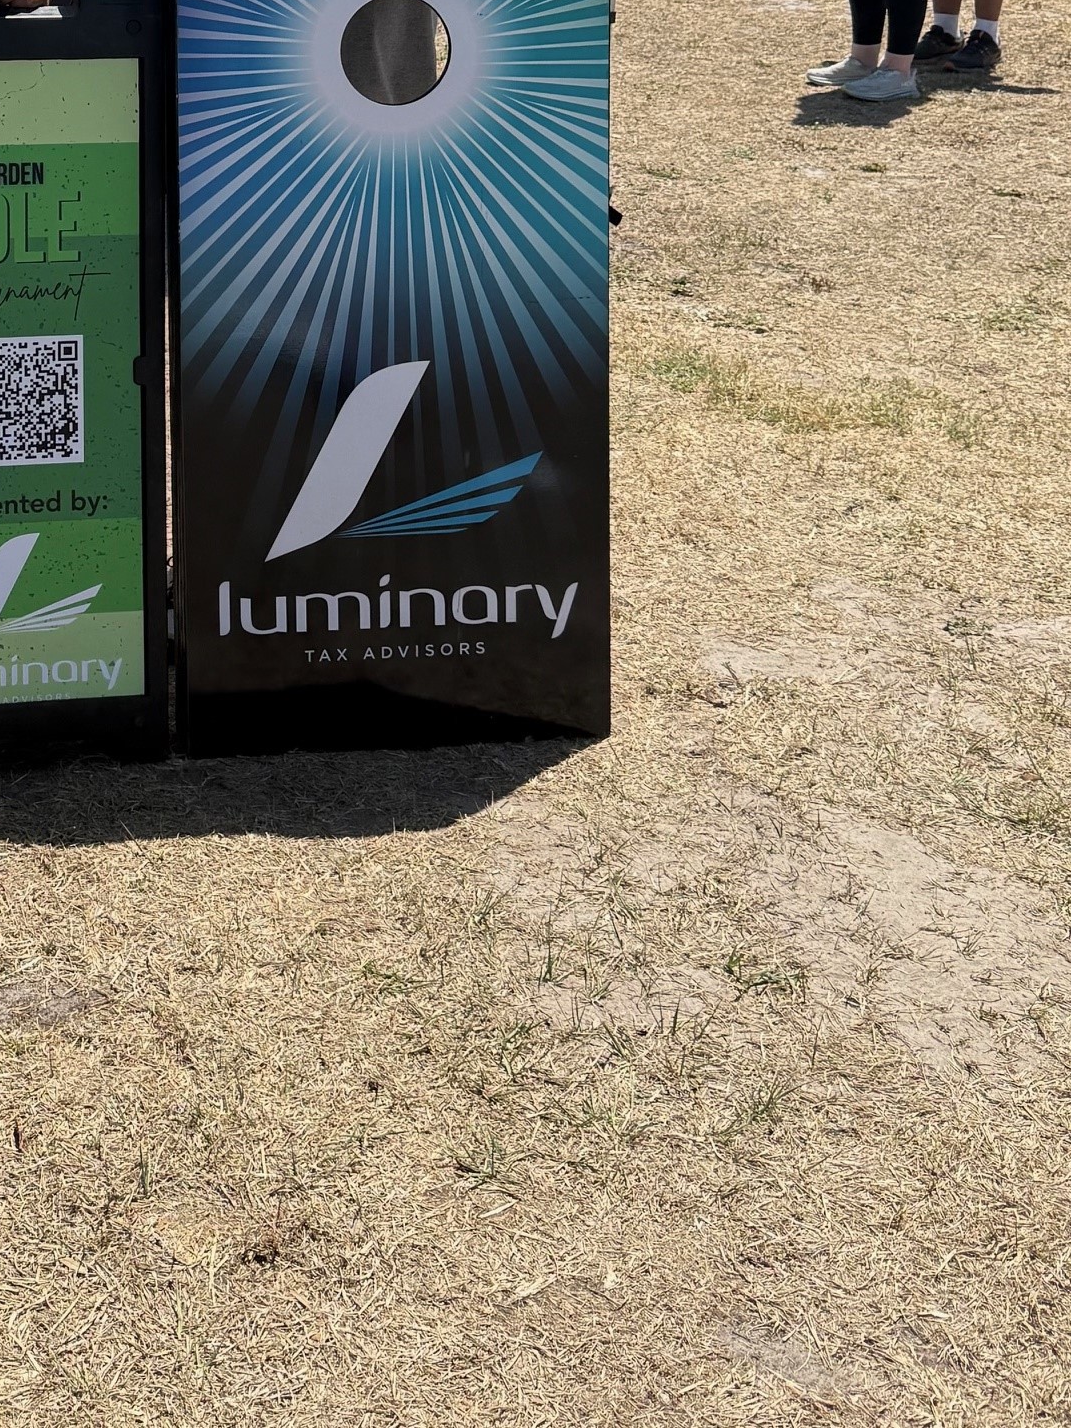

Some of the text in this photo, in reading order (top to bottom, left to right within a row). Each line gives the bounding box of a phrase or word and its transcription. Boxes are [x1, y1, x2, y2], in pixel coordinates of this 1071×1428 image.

[71, 489, 109, 517] by:
[219, 574, 579, 639] luminary
[305, 641, 487, 663] TAX ADVISORS
